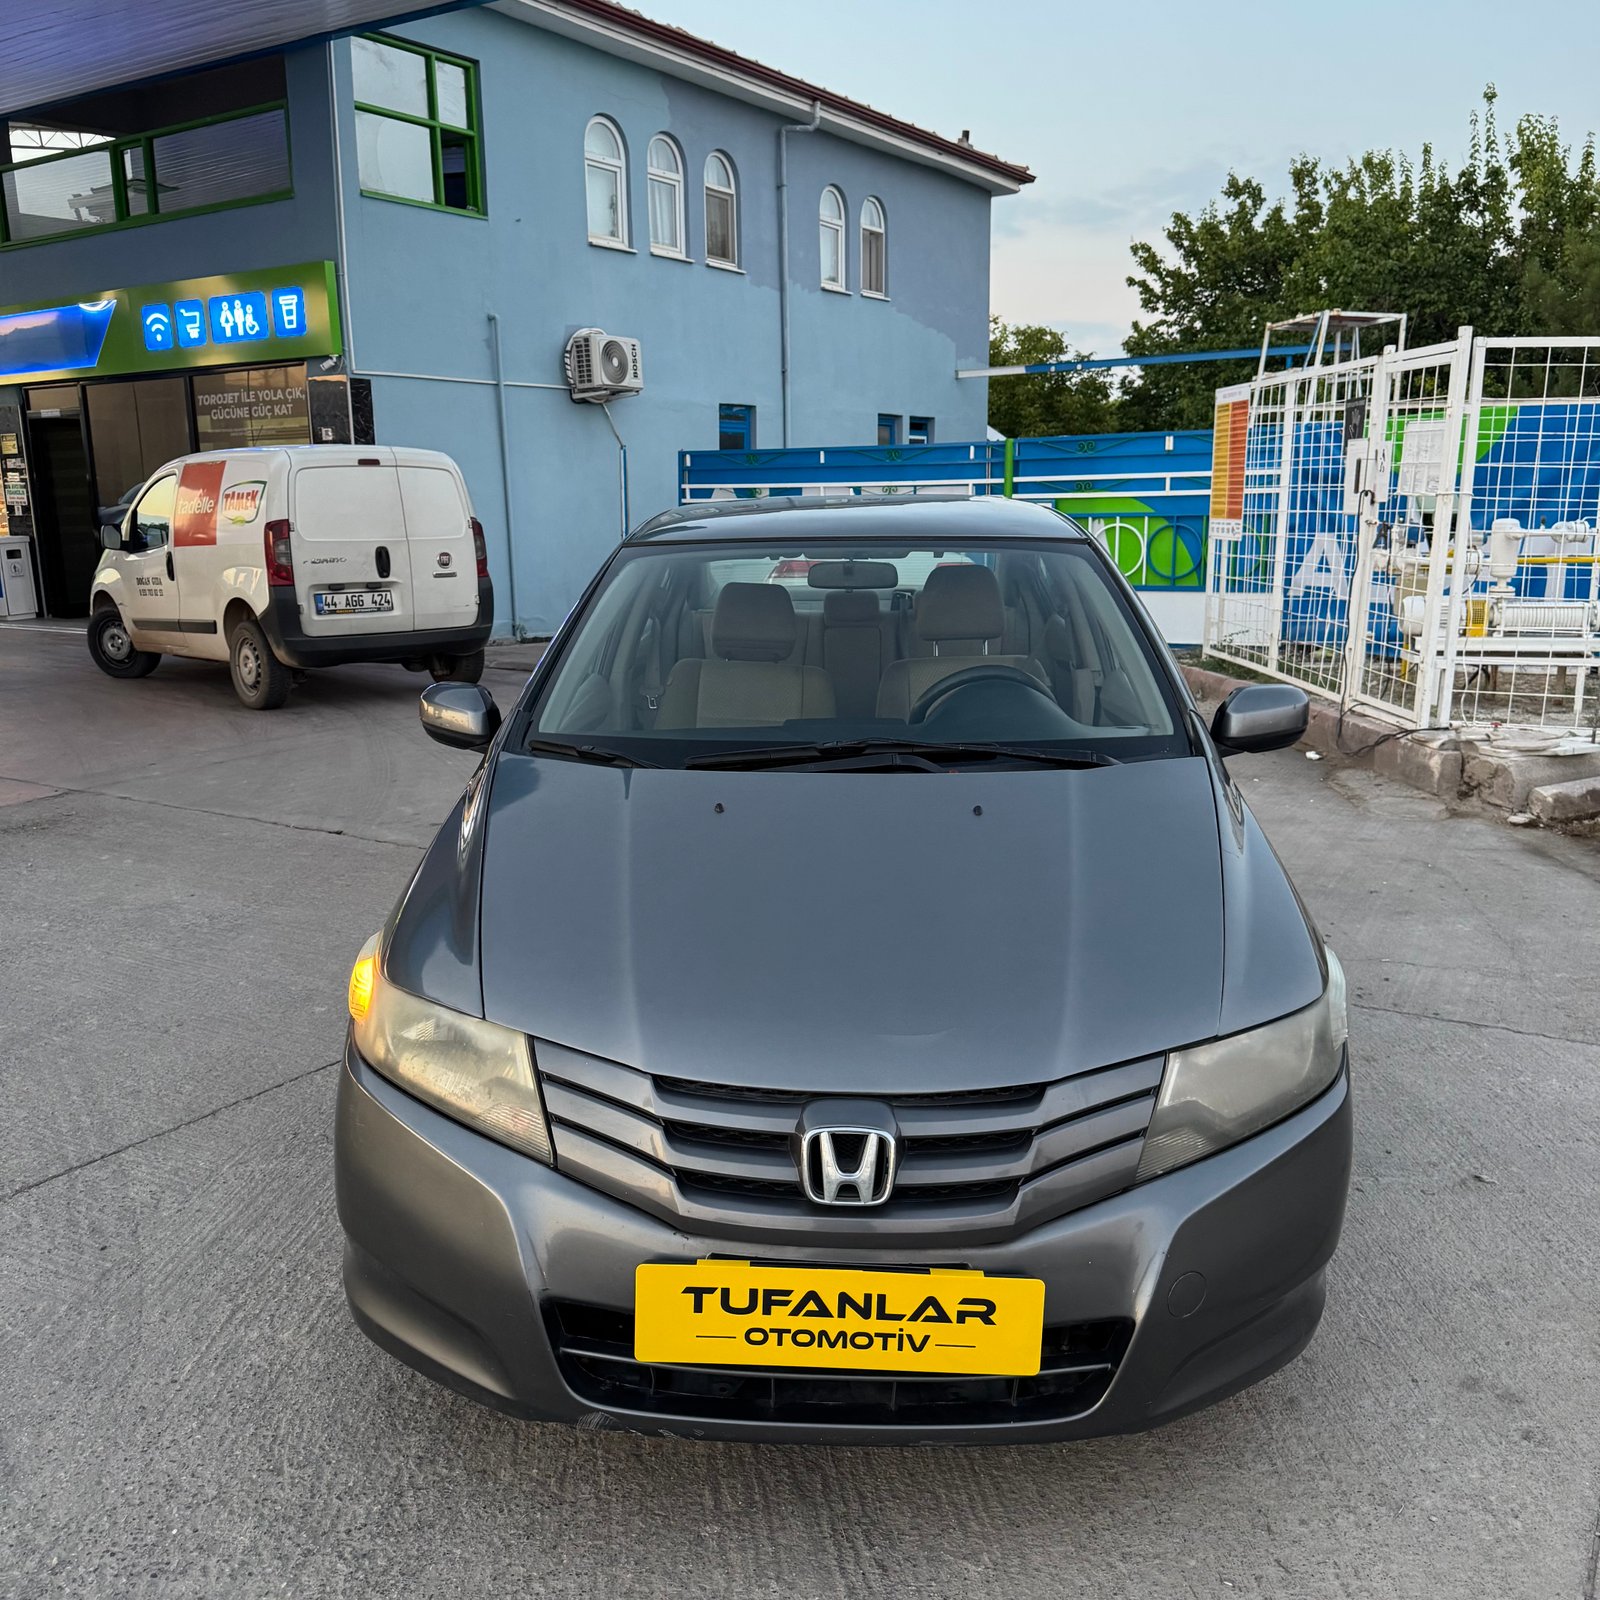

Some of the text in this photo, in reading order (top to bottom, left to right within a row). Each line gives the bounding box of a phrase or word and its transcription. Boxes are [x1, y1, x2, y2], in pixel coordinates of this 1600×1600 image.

[631, 343, 639, 378] BOSCH
[197, 387, 306, 406] TOROJET İLE YOLA ÇIK,
[211, 403, 294, 420] GÜCÜNE GÜÇ KAT
[223, 489, 259, 512] TAMEK
[324, 593, 391, 608] 44 AGG 424
[681, 1286, 997, 1326] TUFANLAR
[744, 1327, 931, 1353] OTOMOTİV
